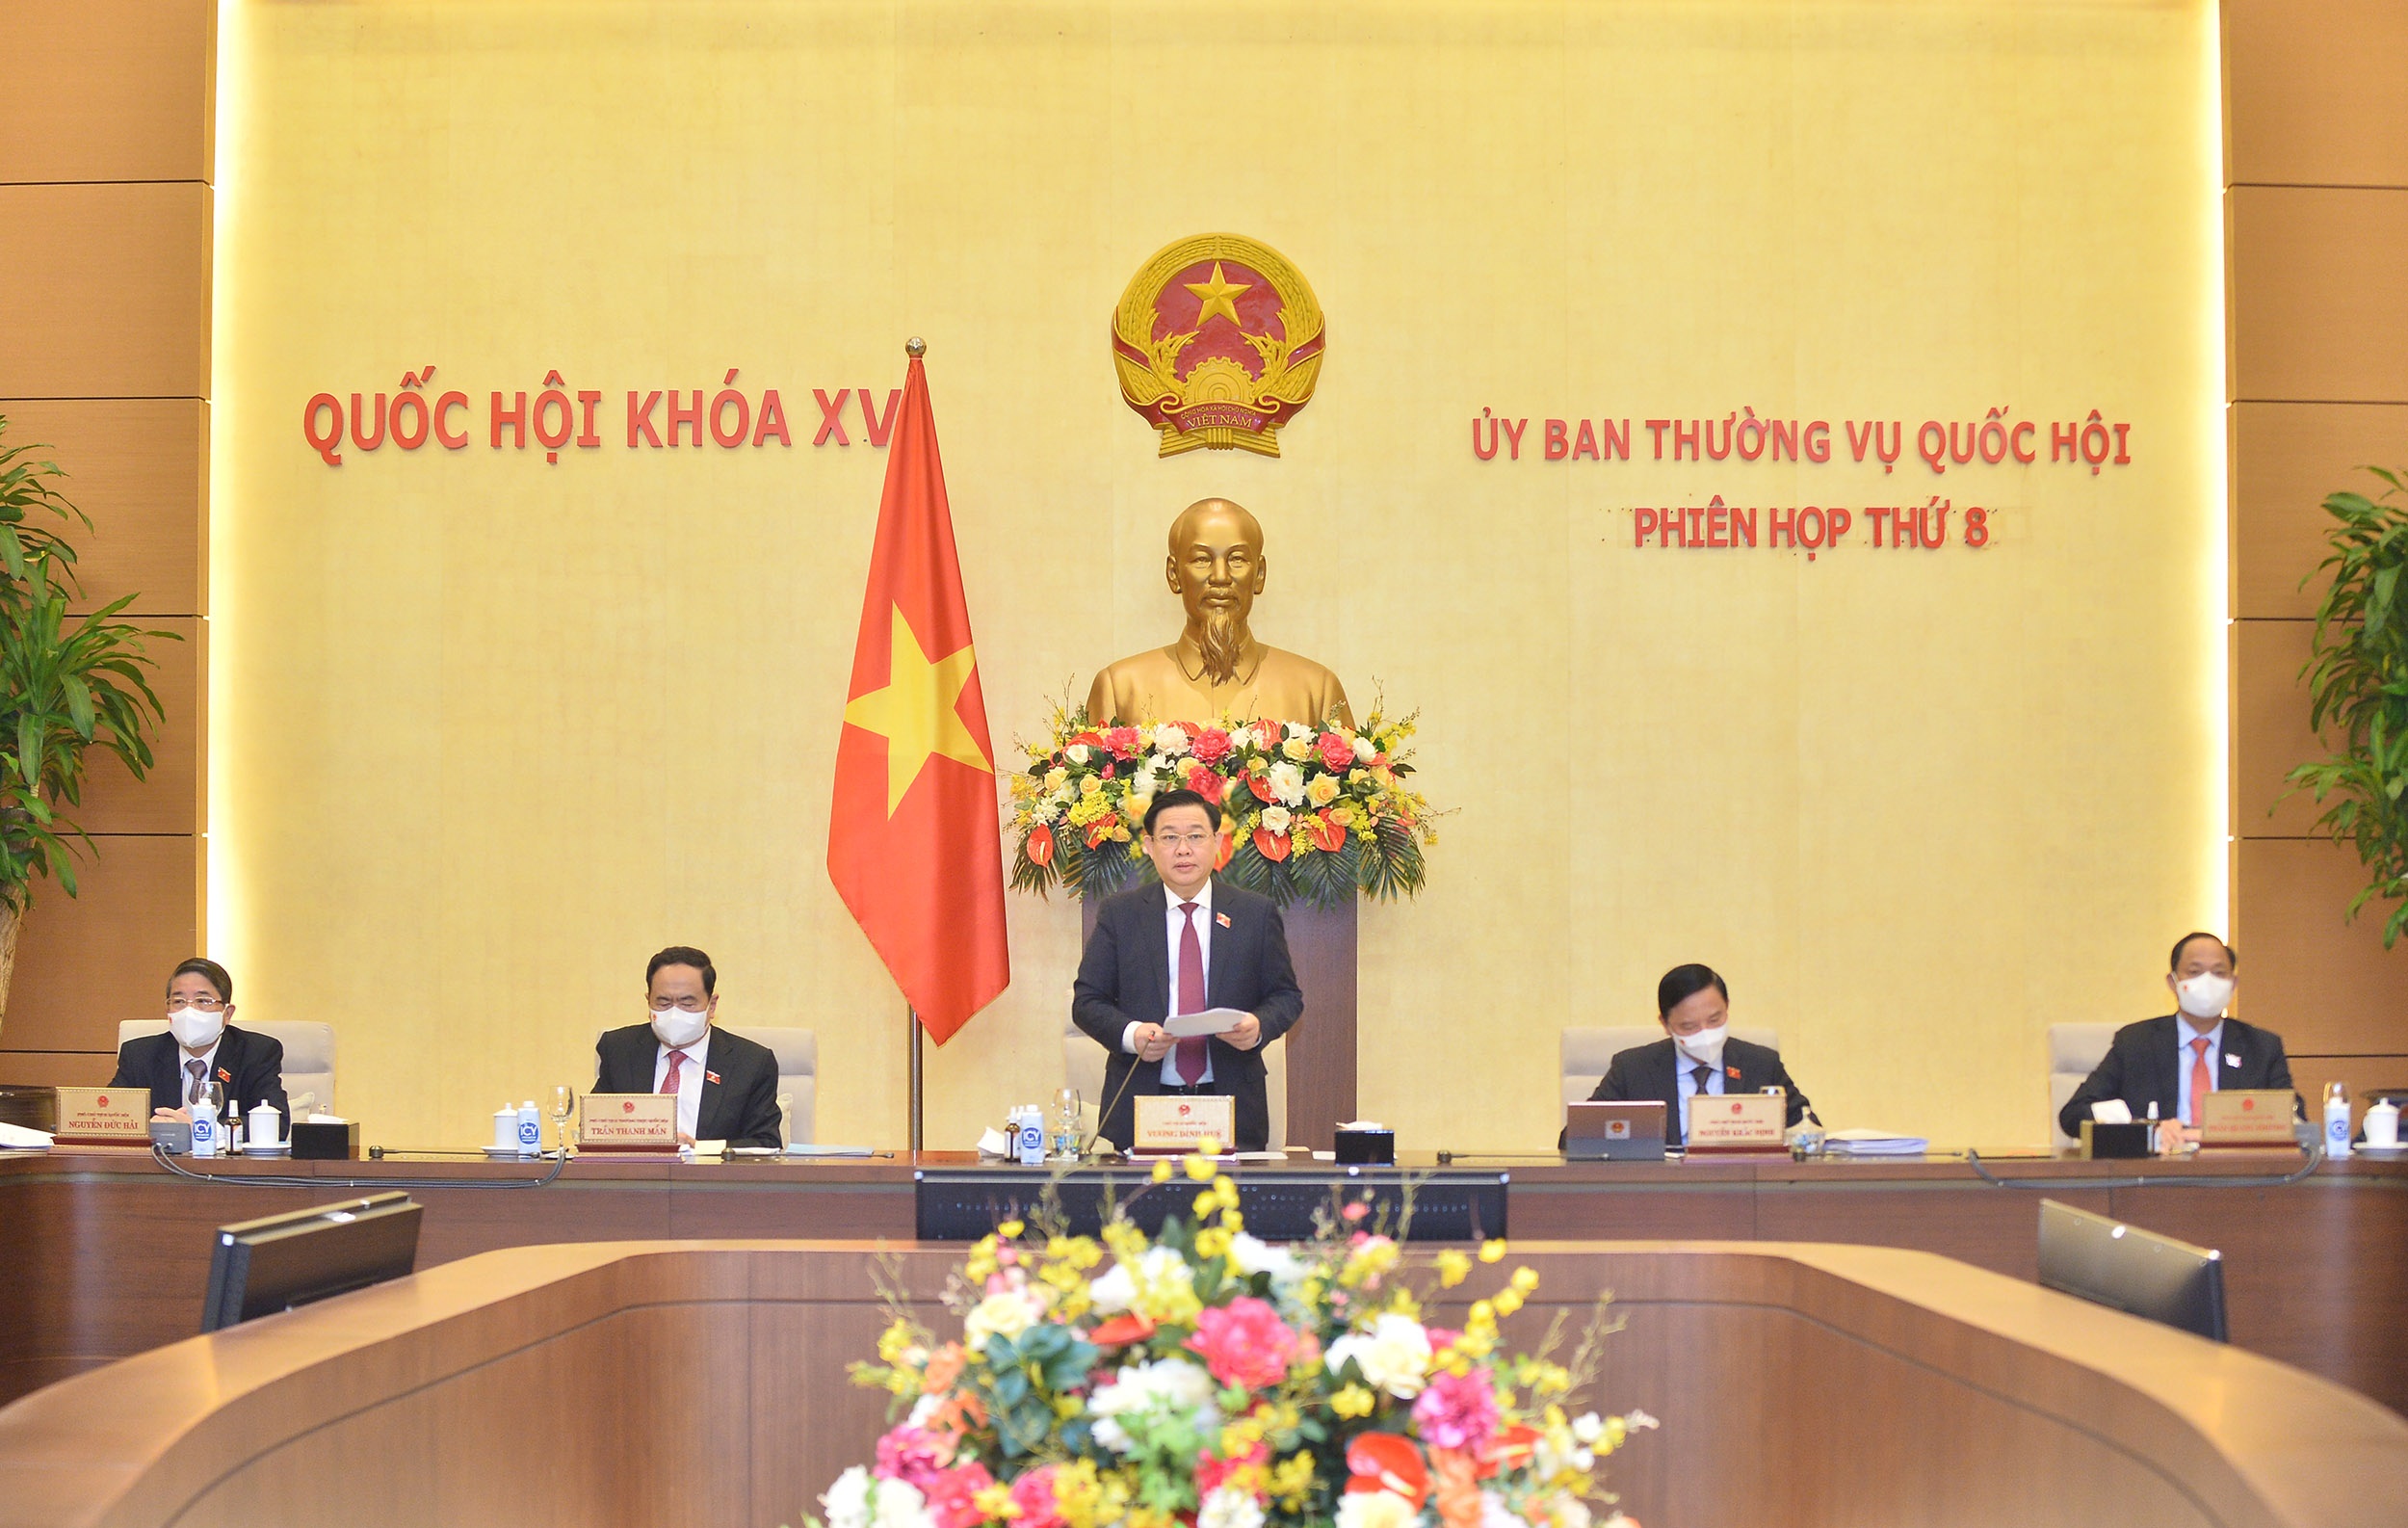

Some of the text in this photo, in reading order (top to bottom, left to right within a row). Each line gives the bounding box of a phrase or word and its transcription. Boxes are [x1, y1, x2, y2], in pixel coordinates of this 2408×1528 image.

[304, 365, 903, 465] QUỐC HỘI KHÓA XV
[1219, 414, 1253, 428] NAM
[1474, 406, 2132, 475] ỦY BAN THƯỜNG VỤ QUỐC HỘI
[1636, 494, 1989, 562] PHIÊN HỌP THỨ 8
[123, 1119, 139, 1129] HẢI
[195, 1122, 210, 1134] ICY
[520, 1125, 537, 1136] ICY
[1023, 1130, 1039, 1142] ICY
